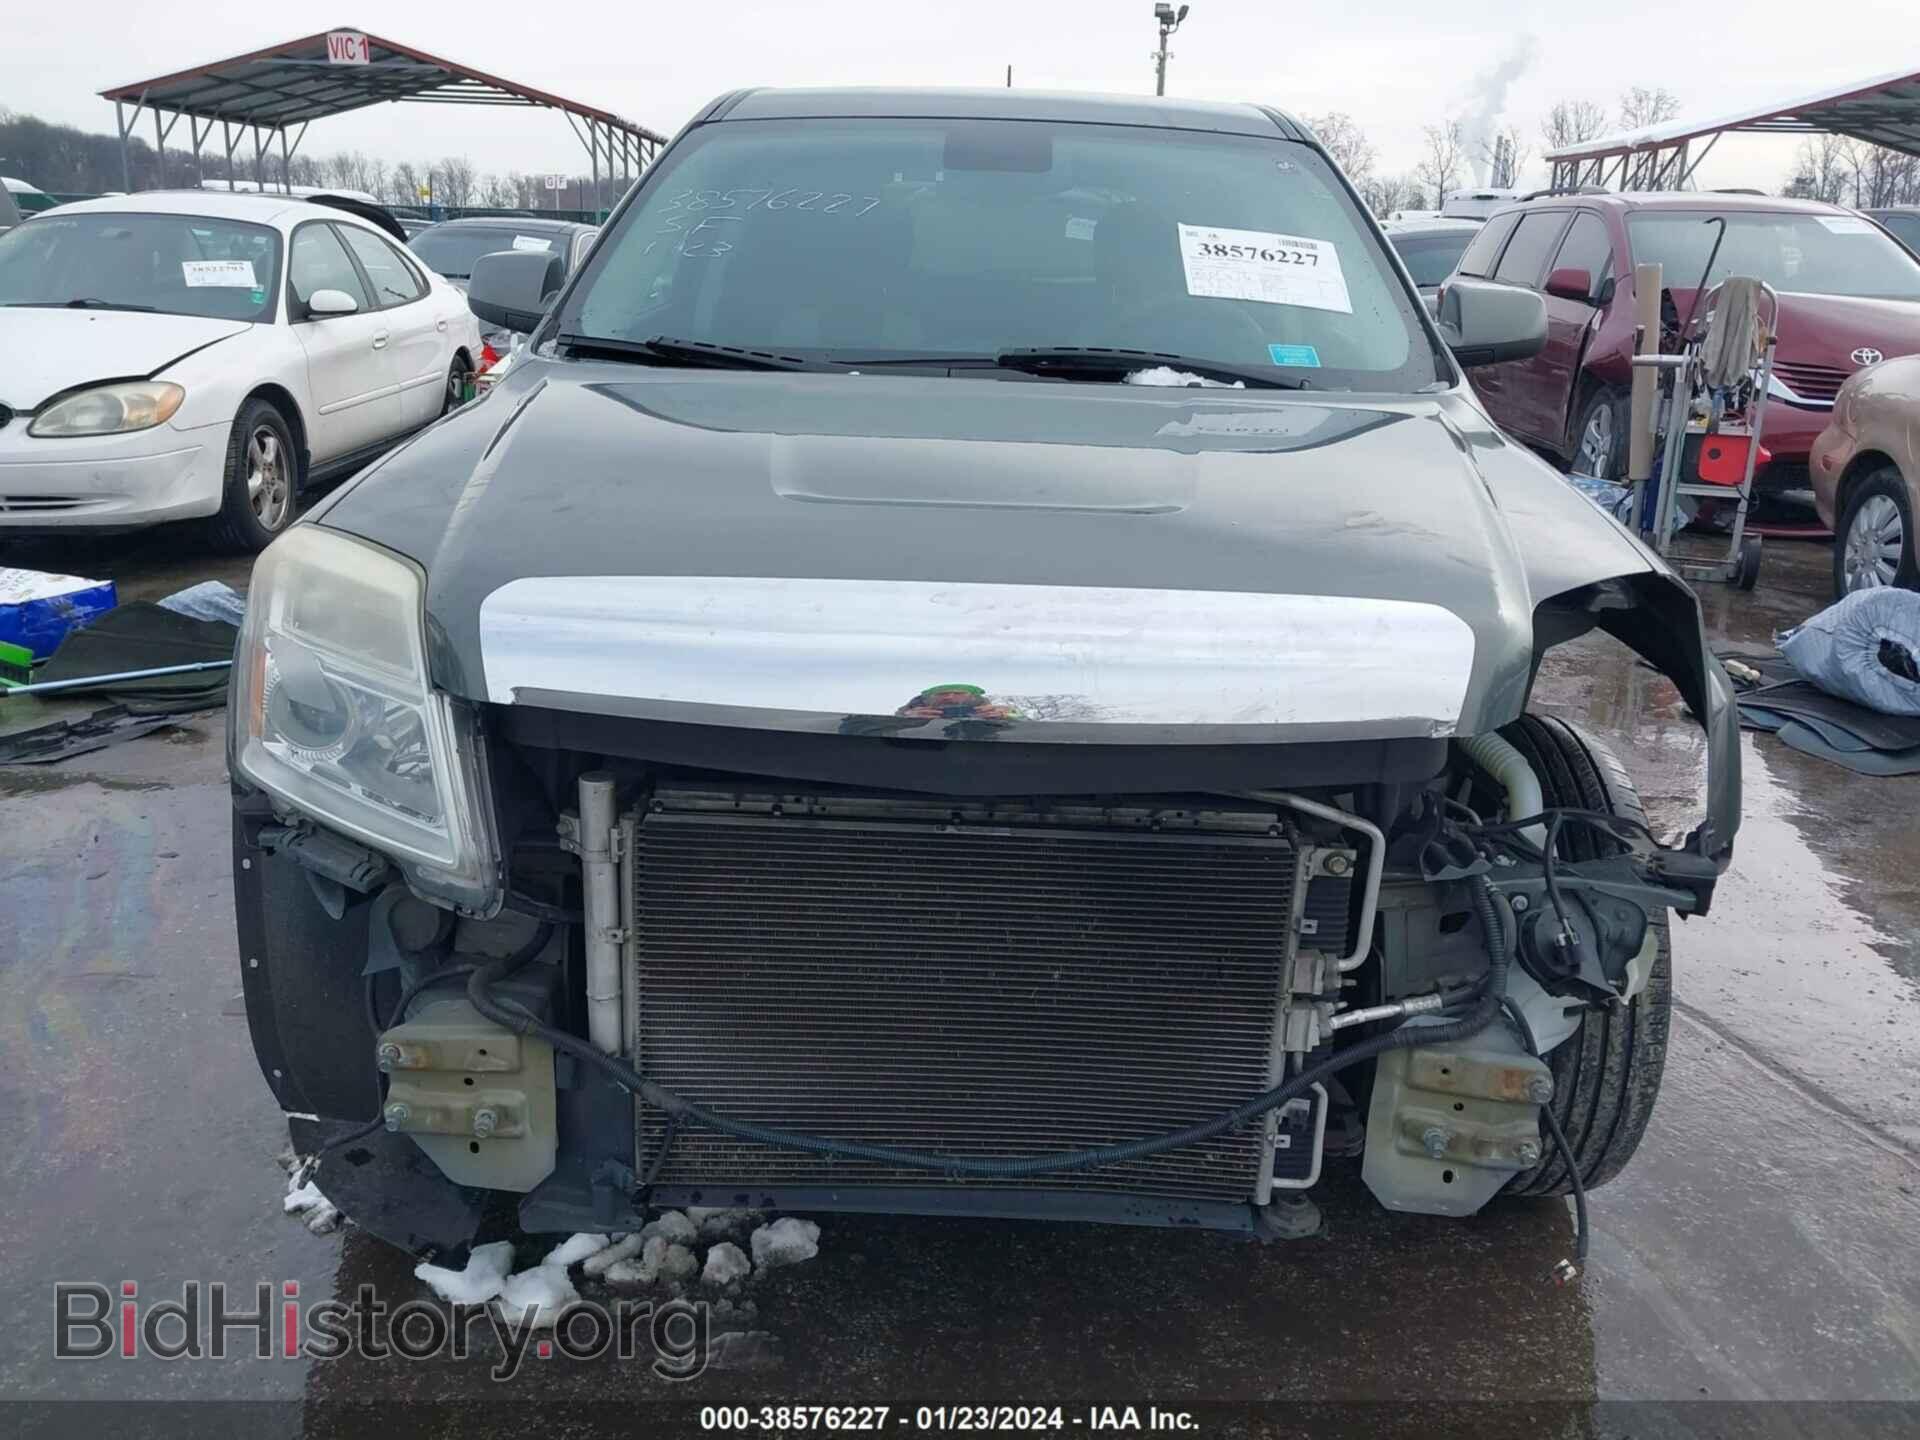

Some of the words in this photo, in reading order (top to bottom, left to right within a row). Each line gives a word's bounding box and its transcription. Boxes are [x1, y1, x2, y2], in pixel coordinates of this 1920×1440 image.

[328, 36, 356, 60] VIC
[358, 37, 368, 60] 1
[658, 188, 881, 216] 38576227
[1198, 242, 1319, 267] 38576227
